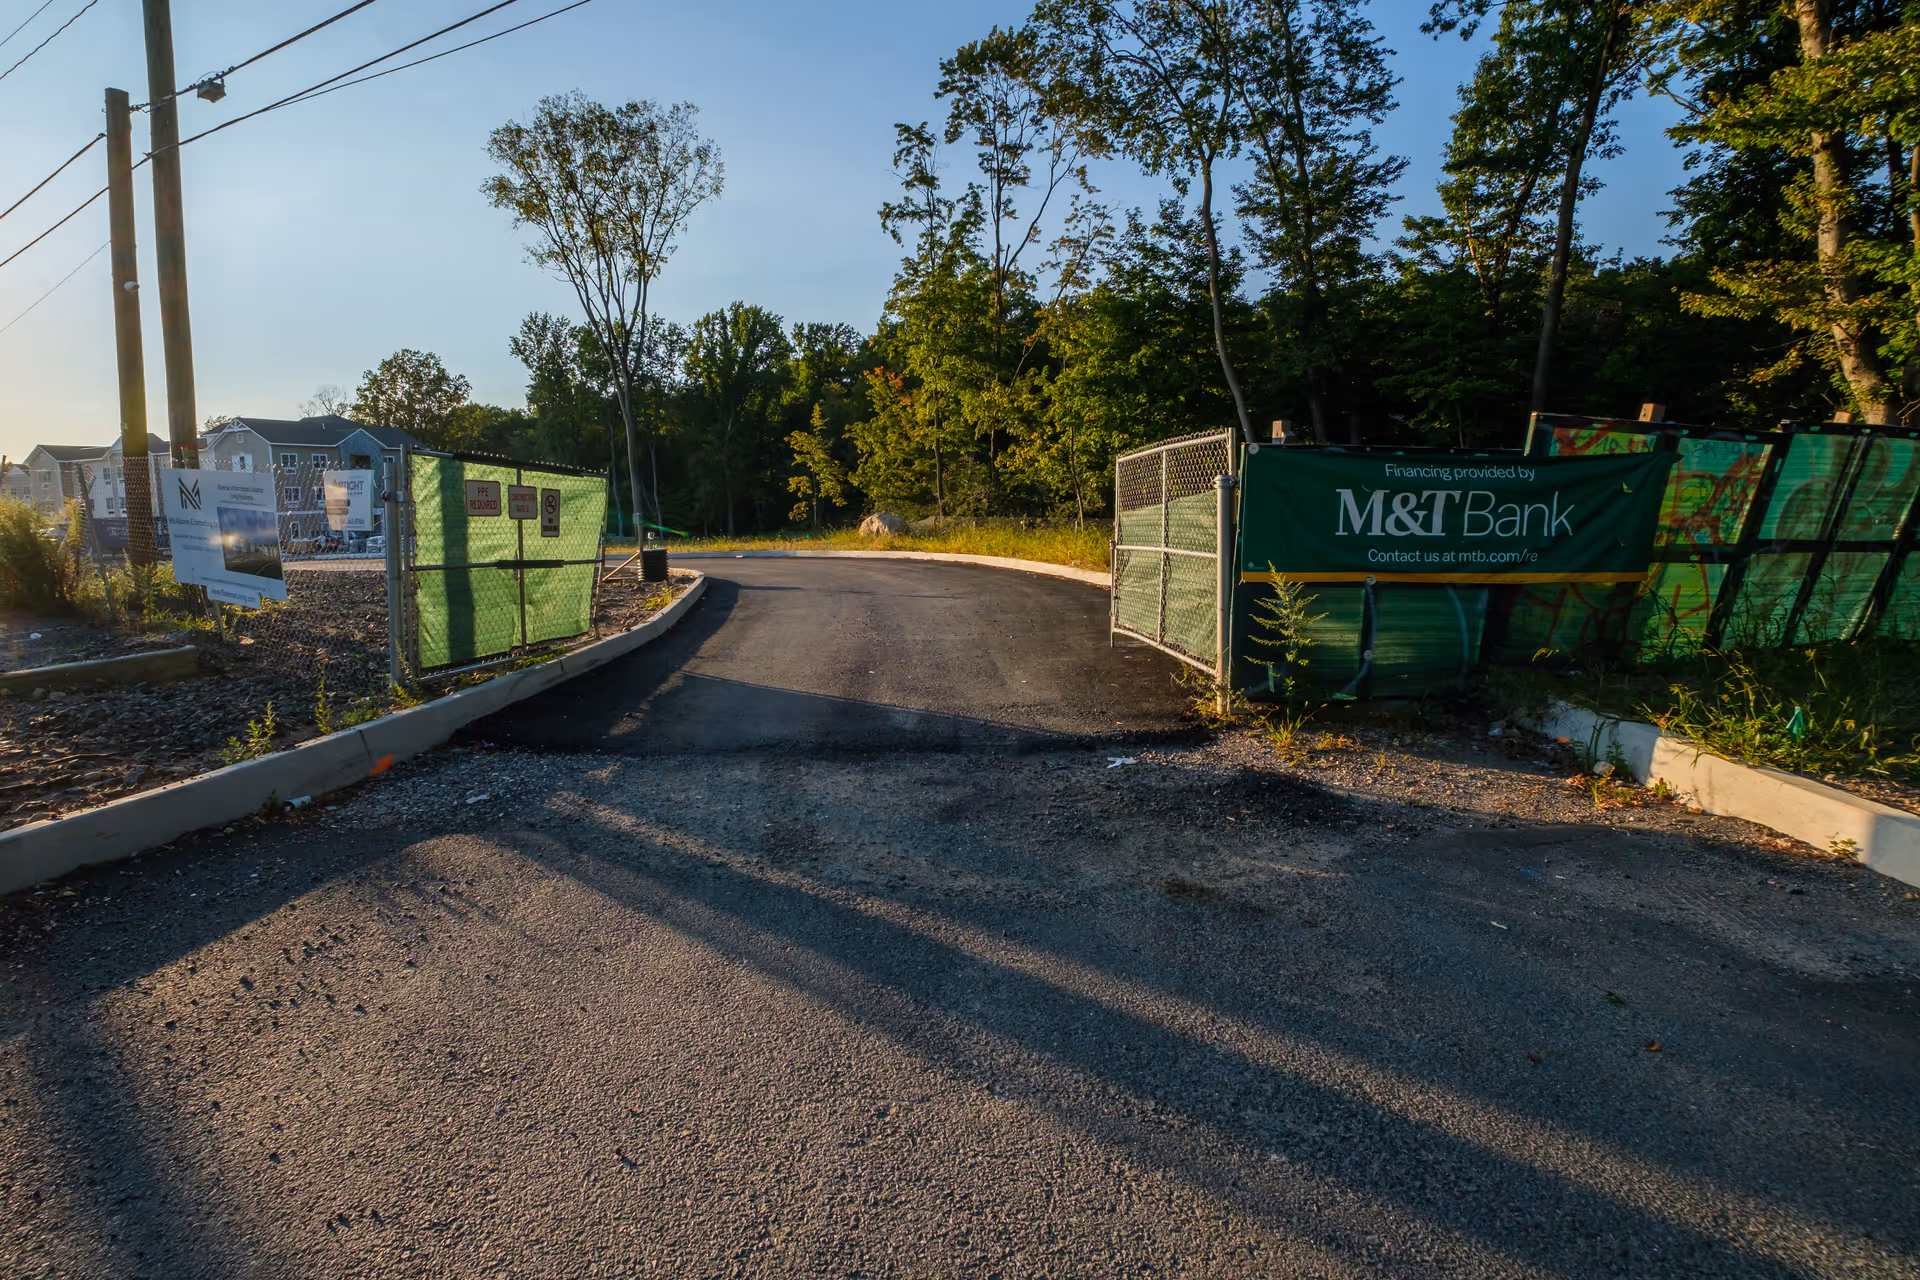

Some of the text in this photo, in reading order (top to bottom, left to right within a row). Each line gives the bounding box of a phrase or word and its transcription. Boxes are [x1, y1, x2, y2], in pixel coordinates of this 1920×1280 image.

[1385, 463, 1536, 482] Financing provided by
[477, 487, 489, 497] PPE
[469, 499, 498, 510] REQUIRED
[1335, 488, 1576, 538] M&T Bank
[1368, 549, 1538, 563] Contact us at mtb.com/re
